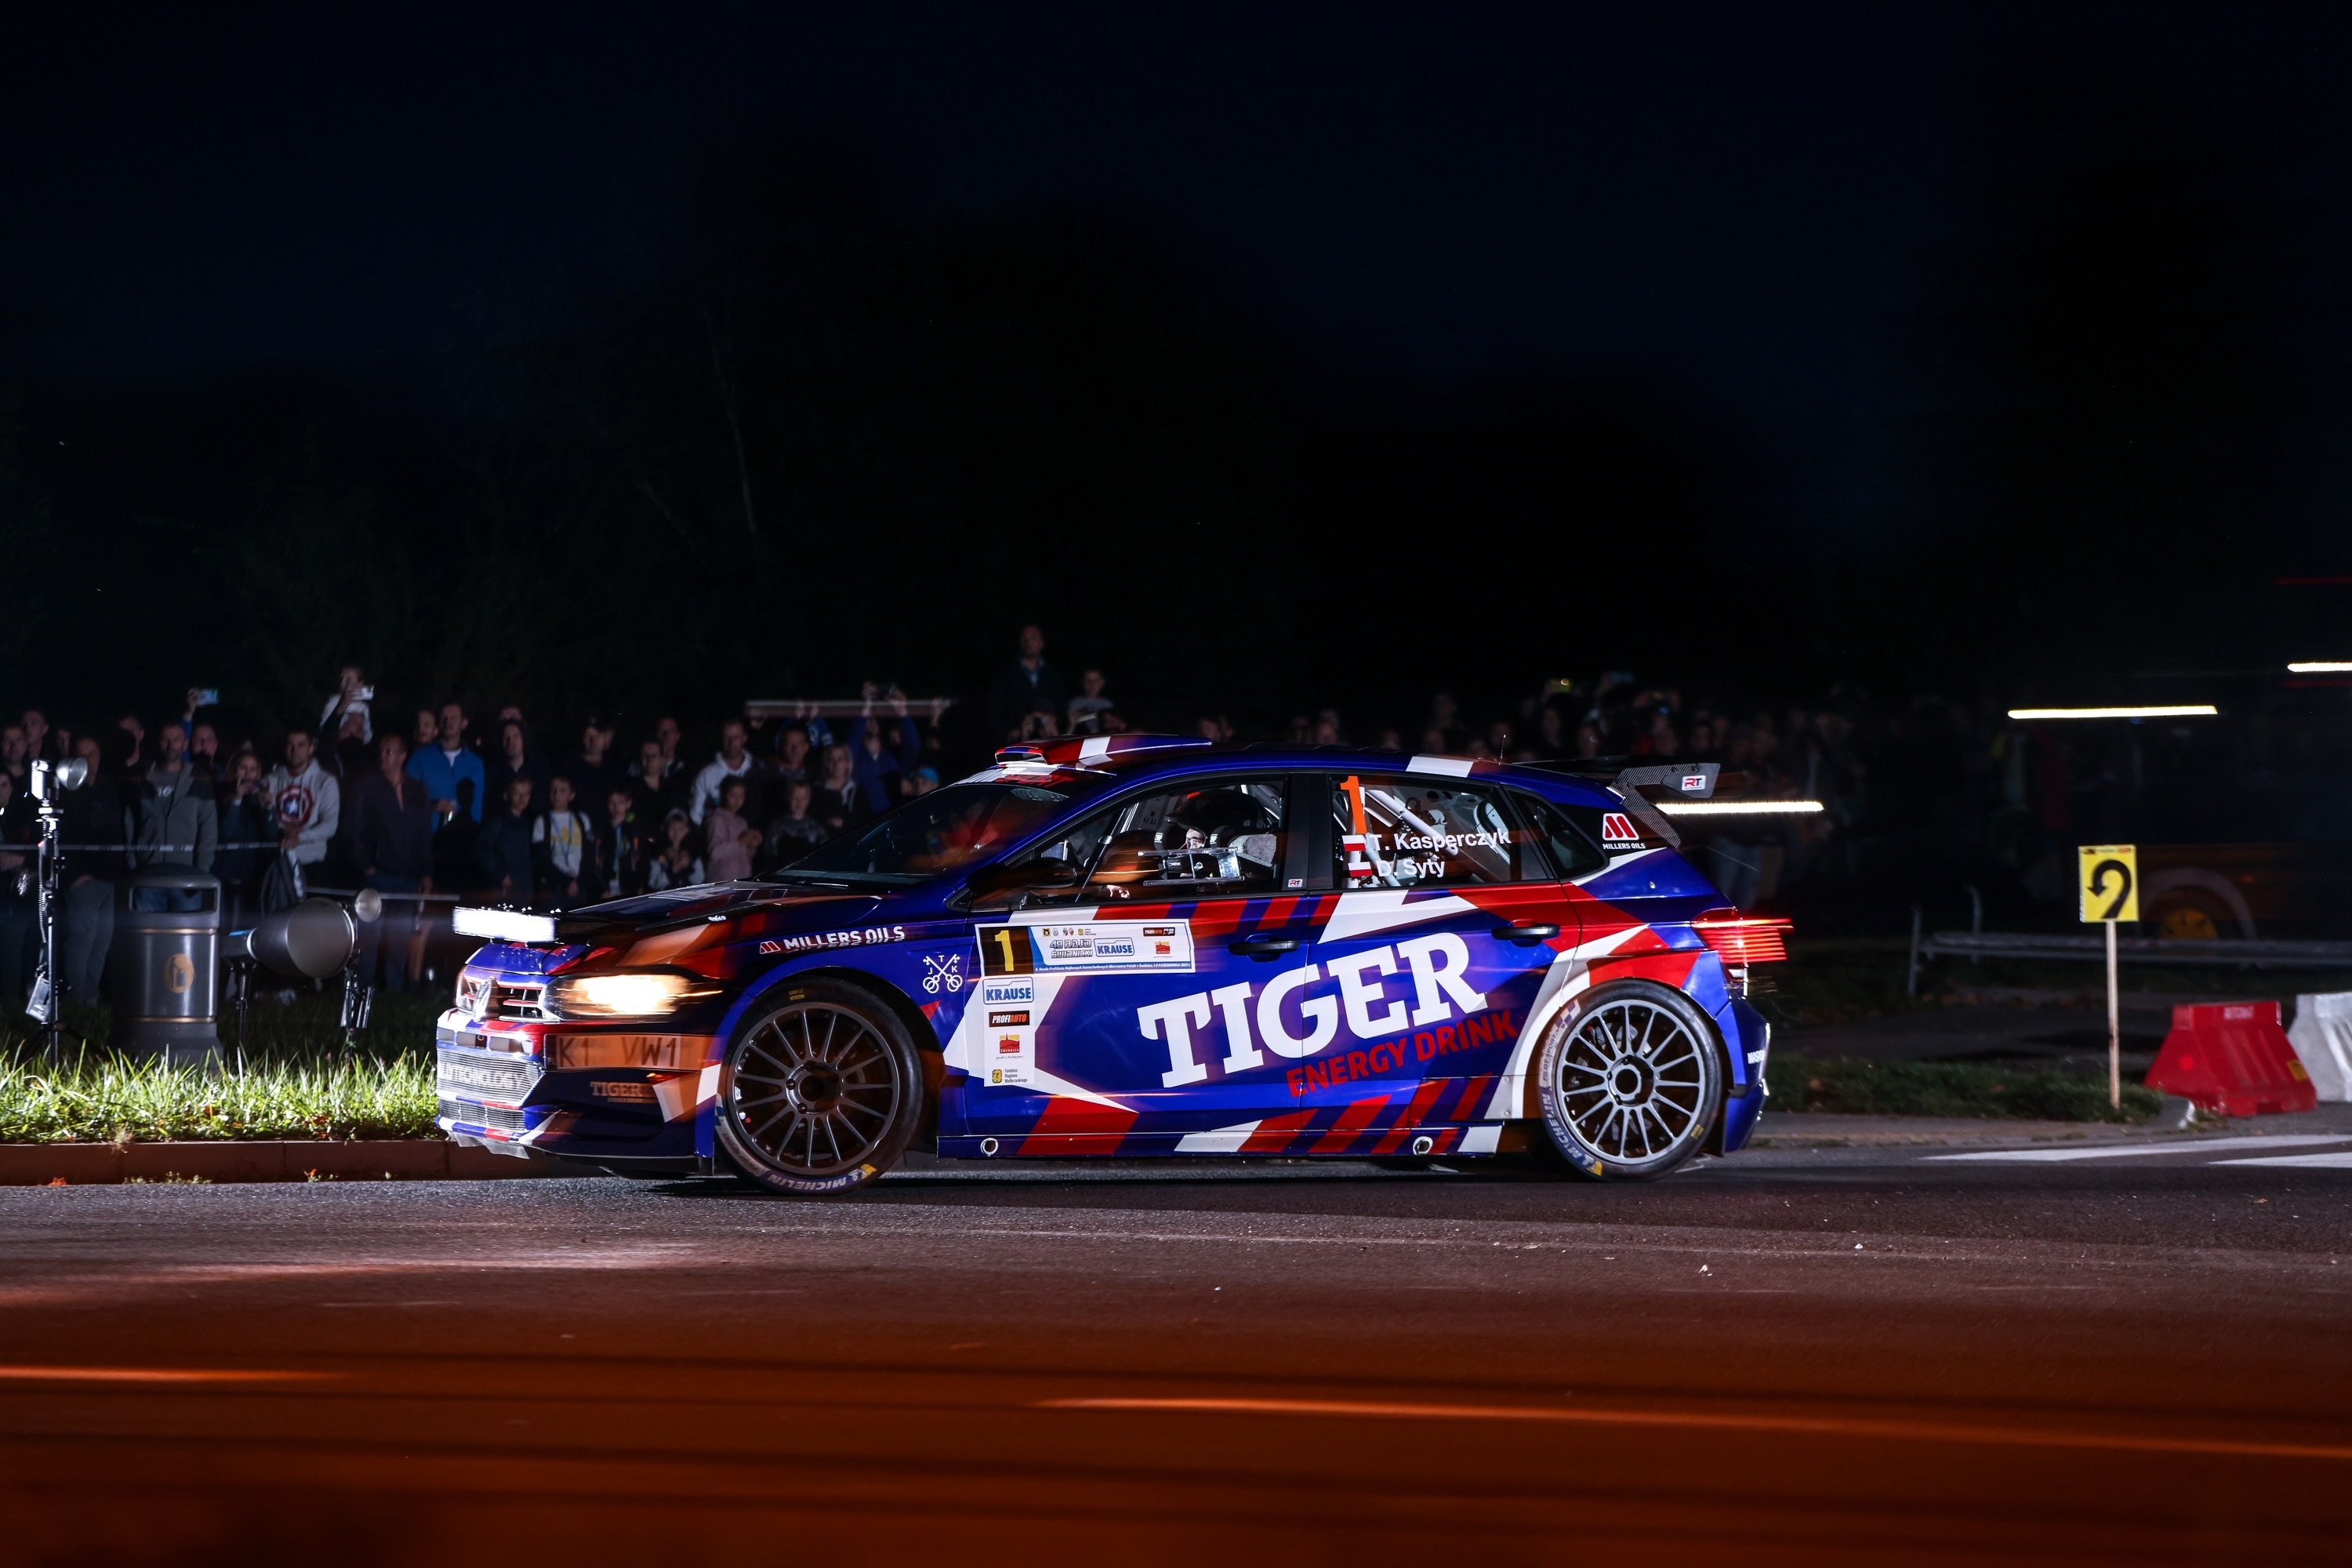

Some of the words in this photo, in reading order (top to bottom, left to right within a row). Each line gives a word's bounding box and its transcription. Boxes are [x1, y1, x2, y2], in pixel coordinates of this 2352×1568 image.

[1684, 778, 1702, 786] RT
[1340, 775, 1367, 834] 1
[1370, 835, 1389, 851] T.
[1394, 828, 1512, 852] Kasperczyk
[1377, 862, 1398, 877] D.
[1404, 858, 1445, 879] Syty
[783, 930, 861, 949] MILLERS
[865, 926, 905, 940] OILS
[994, 930, 1014, 971] 1
[1097, 945, 1132, 954] KRAUSE
[985, 987, 1032, 1001] KRAUSE
[992, 1014, 1027, 1024] PROFIAUTO
[1137, 932, 1488, 1088] TIGER
[559, 1036, 590, 1067] K1
[620, 1036, 677, 1067] VW1
[1286, 1037, 1407, 1098] ENERGY
[1415, 1009, 1518, 1062] DRINK
[590, 1081, 643, 1097] TIGER
[1542, 1093, 1581, 1160] MICHELIN
[768, 1174, 847, 1191] MICHELIN
